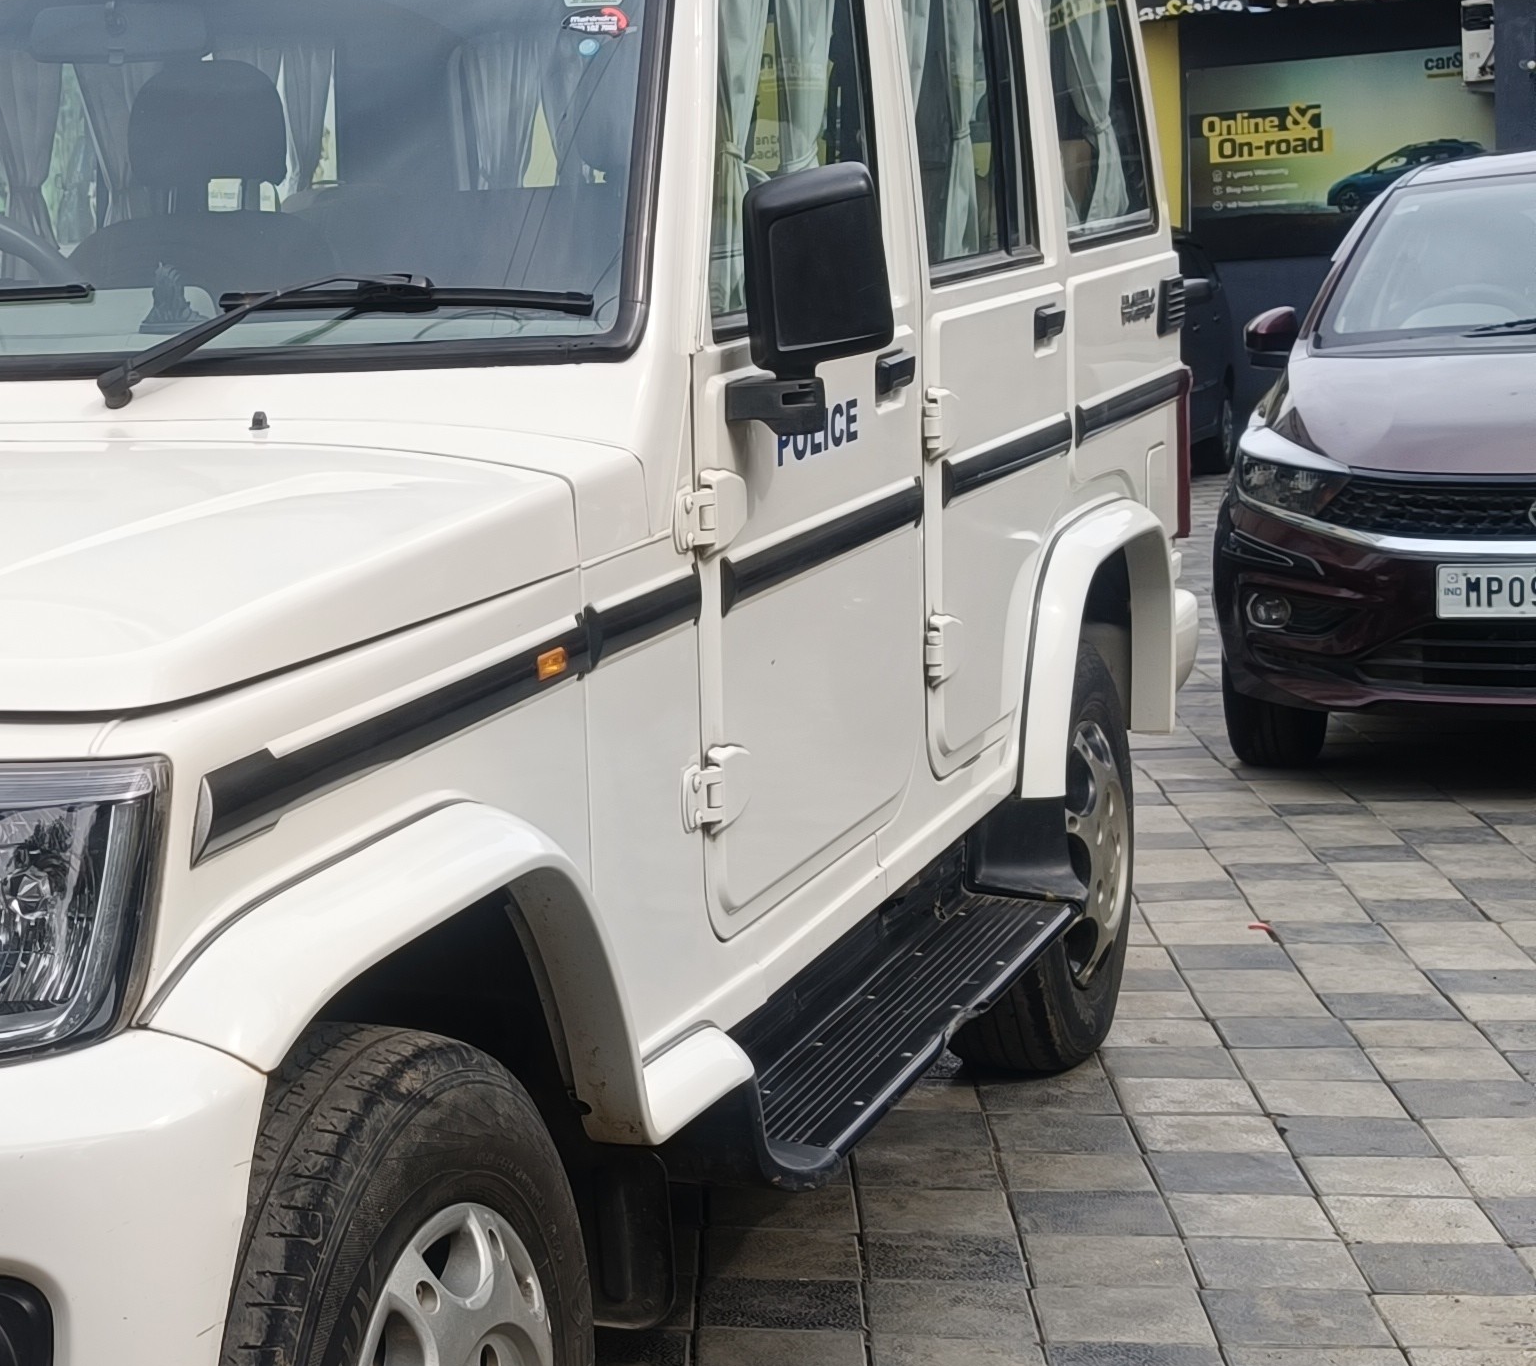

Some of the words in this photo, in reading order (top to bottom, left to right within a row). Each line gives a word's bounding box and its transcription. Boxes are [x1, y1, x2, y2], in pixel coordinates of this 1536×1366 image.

[1202, 112, 1279, 137] Online
[1285, 101, 1321, 131] &
[1218, 129, 1324, 159] On-road
[1444, 586, 1462, 596] IND
